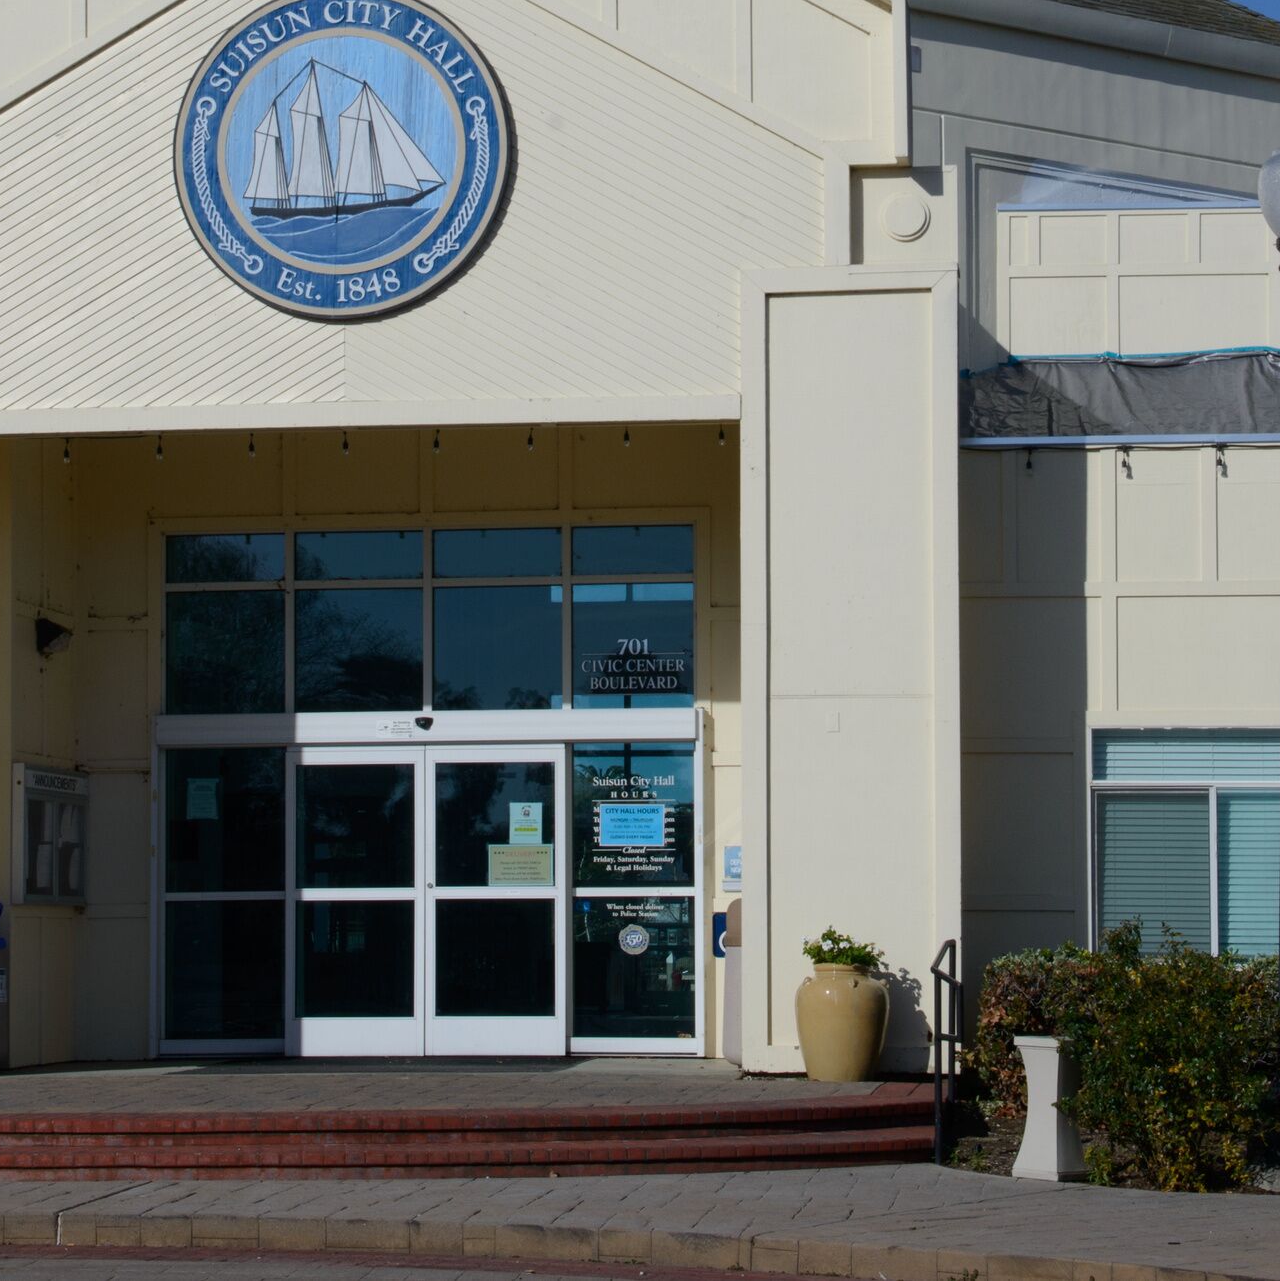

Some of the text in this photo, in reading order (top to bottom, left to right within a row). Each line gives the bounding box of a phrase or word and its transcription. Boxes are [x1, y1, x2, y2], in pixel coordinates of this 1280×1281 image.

[210, 0, 476, 94] SUISUN CITY HALL
[276, 266, 402, 303] Est. 1848
[617, 638, 649, 655] 701
[581, 658, 685, 673] CIVIC CENTER
[590, 675, 678, 690] BOULEVARD
[592, 775, 675, 788] Suisun City Hall
[622, 846, 647, 854] Closed
[593, 856, 675, 864] Friday, Saturday, Sunday
[633, 864, 662, 872] Holidays
[626, 934, 643, 946] 150
